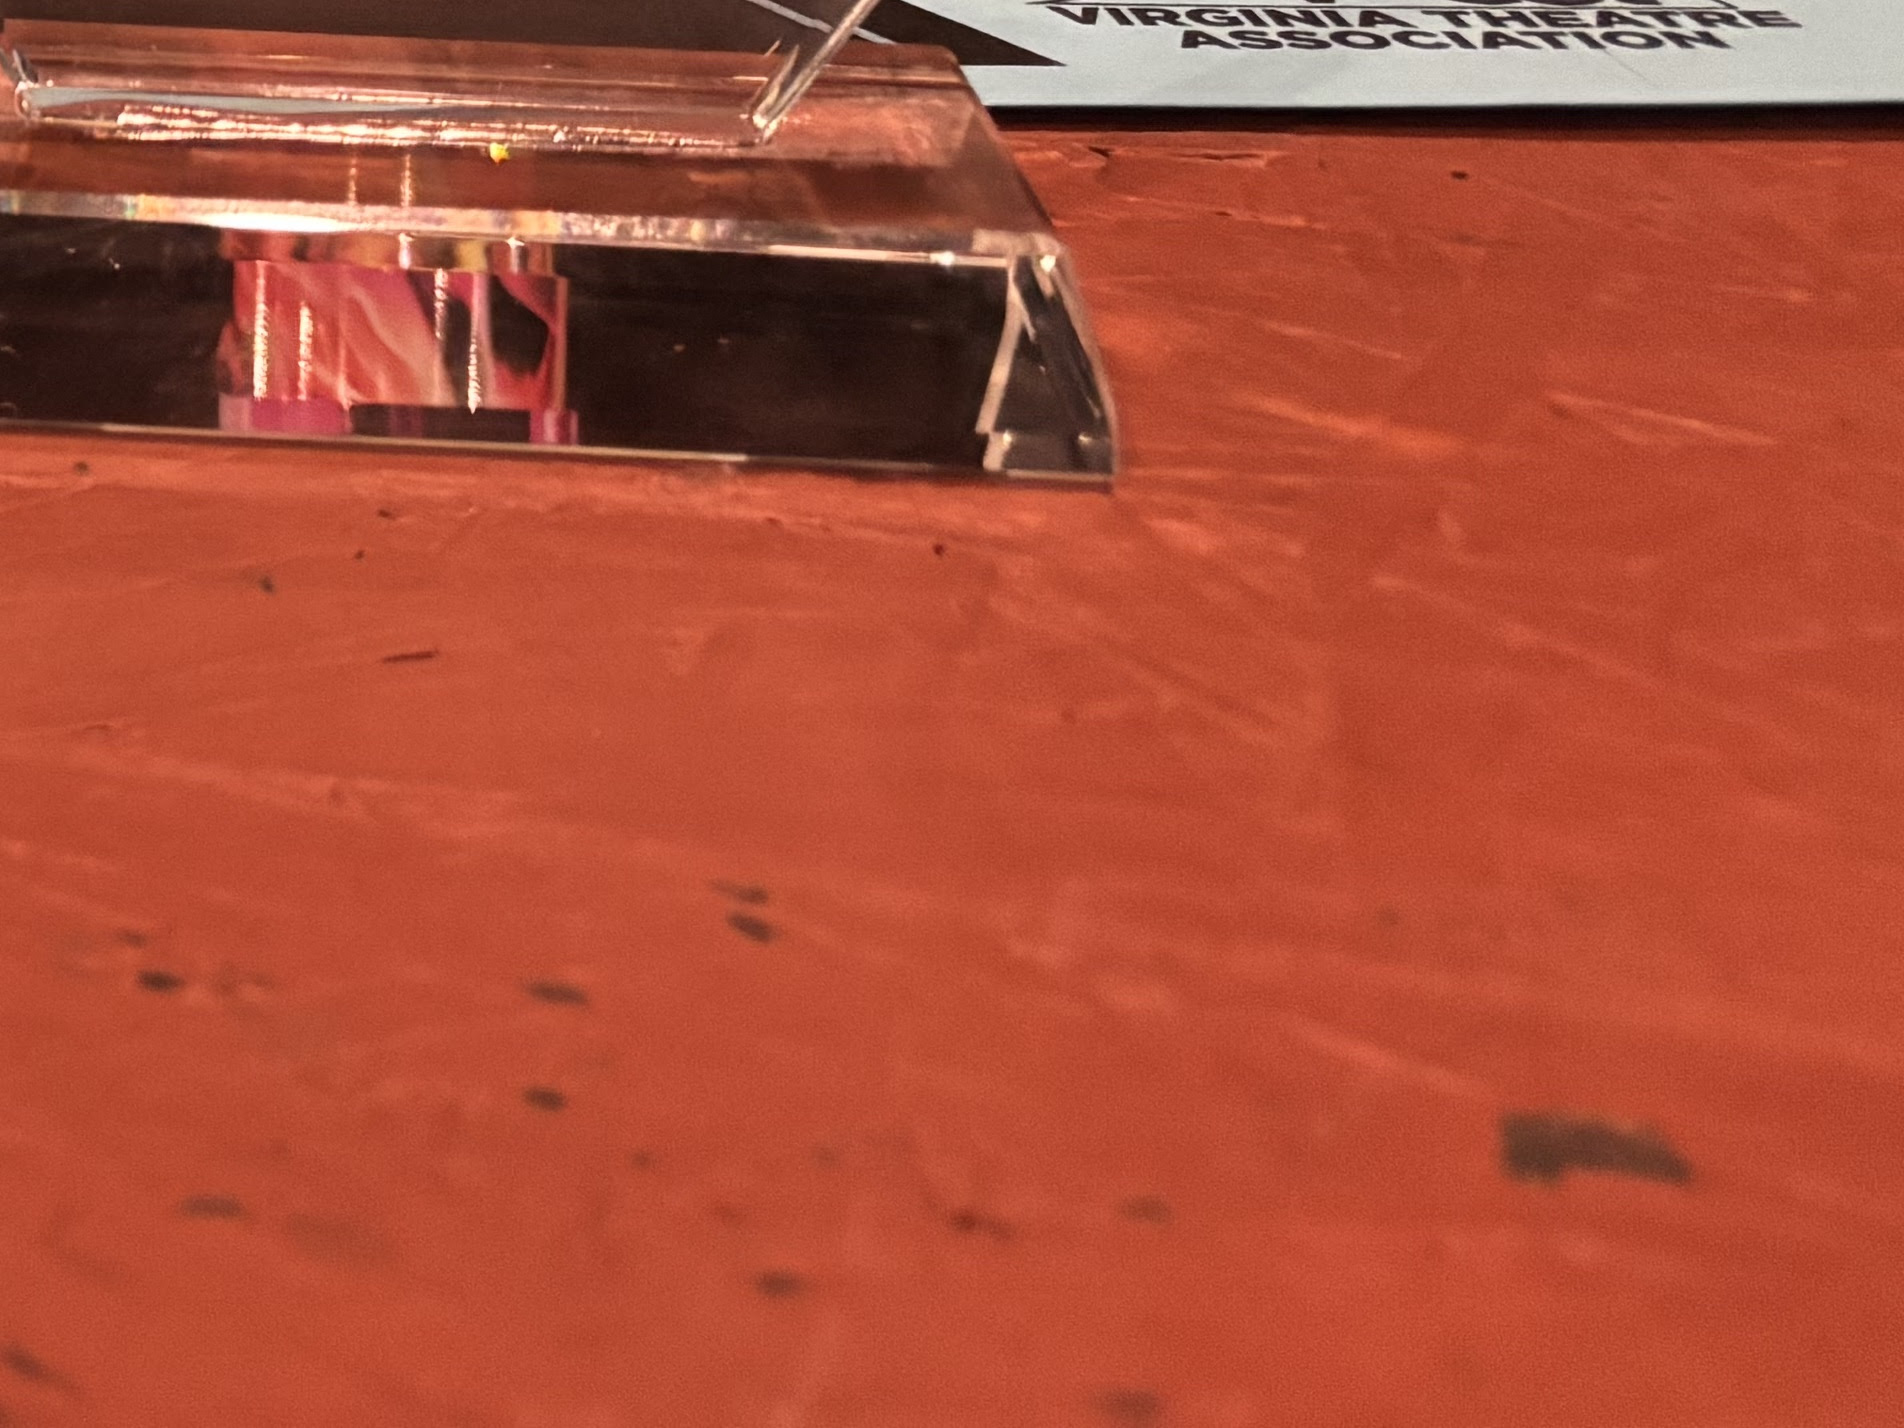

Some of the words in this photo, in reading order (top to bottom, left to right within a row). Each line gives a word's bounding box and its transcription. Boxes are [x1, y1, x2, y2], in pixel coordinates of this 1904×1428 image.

[1046, 6, 1414, 28] VIRGINIA
[1418, 8, 1804, 29] THEATRE
[1180, 29, 1737, 51] ASSOCIATION
